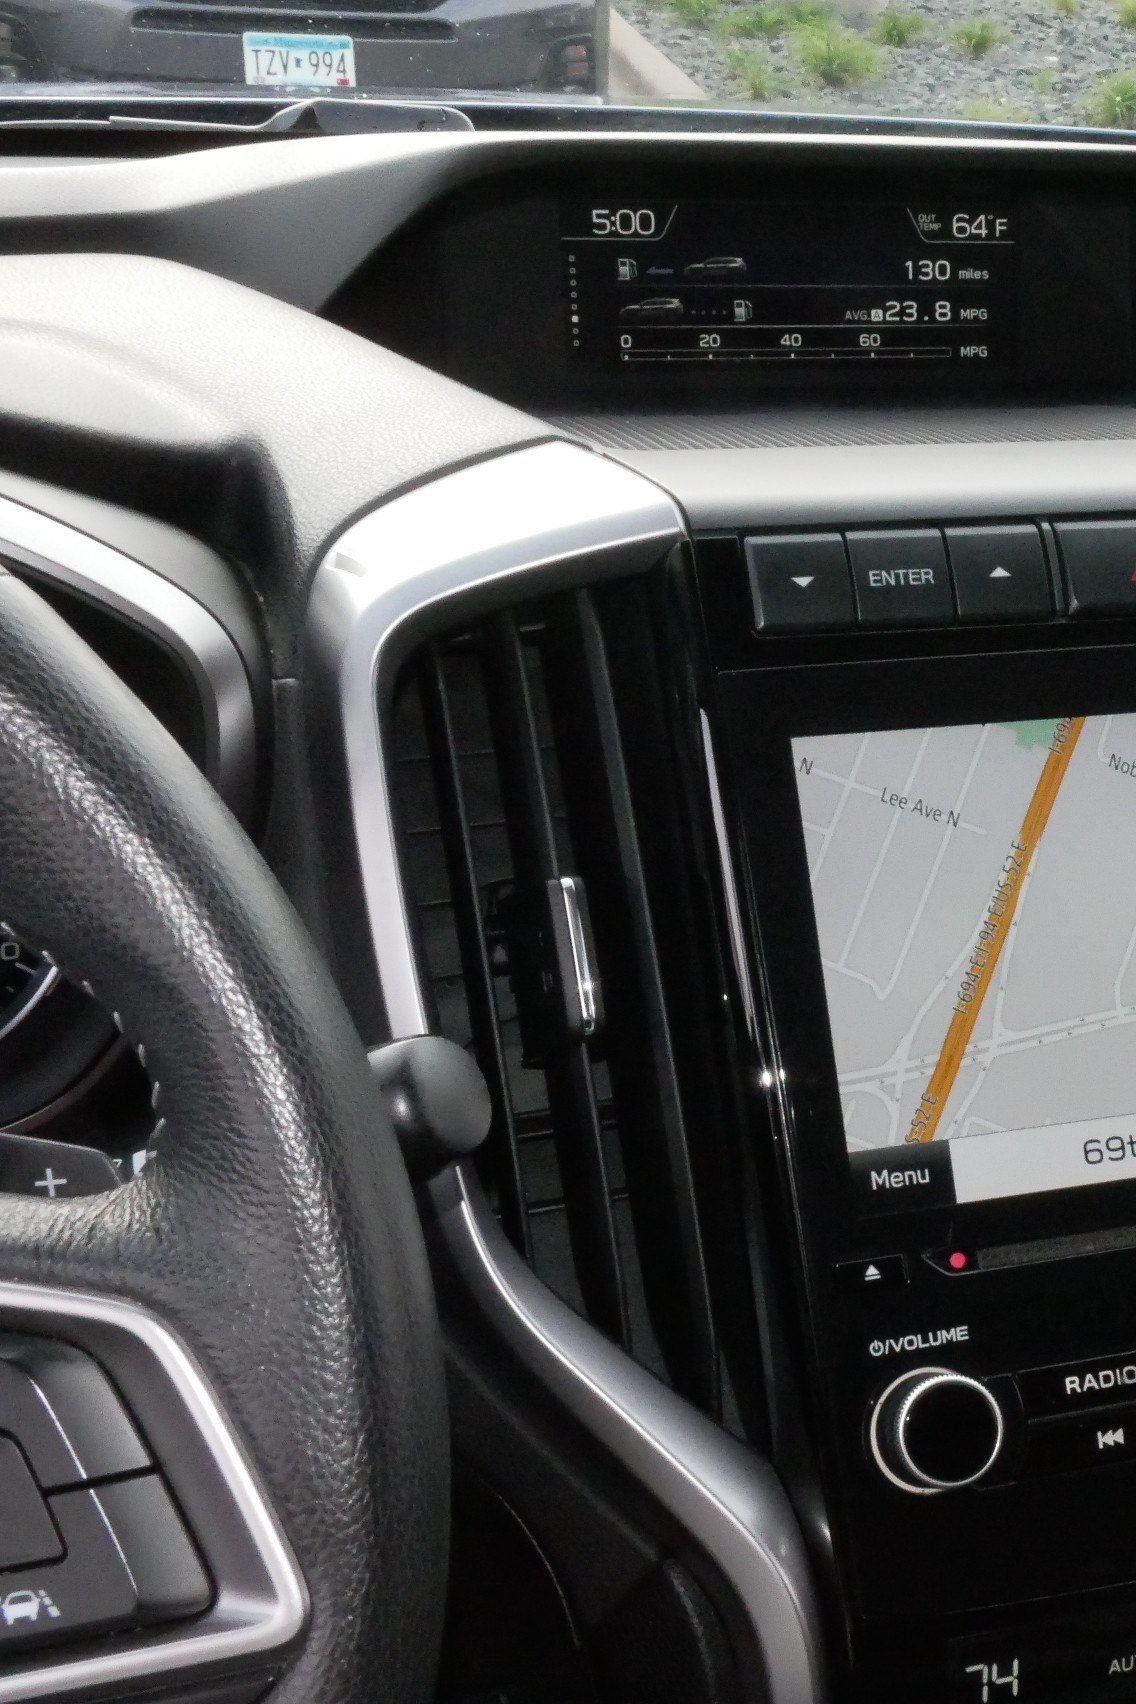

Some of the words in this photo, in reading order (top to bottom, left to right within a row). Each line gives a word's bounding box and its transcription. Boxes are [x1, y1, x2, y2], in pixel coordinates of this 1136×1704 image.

[252, 48, 289, 76] TZV
[308, 50, 347, 77] 994
[592, 208, 655, 235] 5:00
[917, 213, 936, 222] OUT
[919, 222, 941, 231] TEMP
[904, 260, 951, 280] 130
[958, 268, 989, 280] miles
[885, 300, 951, 321] 23.8
[960, 308, 988, 320] MPG
[620, 333, 632, 348] 0
[699, 333, 721, 347] 20
[780, 333, 802, 347] 40
[859, 333, 881, 347] 60
[960, 346, 988, 358] MPG
[867, 567, 935, 588] ENTER
[799, 757, 814, 776] N
[880, 787, 909, 809] Lee
[911, 798, 942, 823] Ave
[947, 809, 961, 828] N
[871, 1168, 930, 1190] Menu
[965, 1658, 1018, 1704] 74
